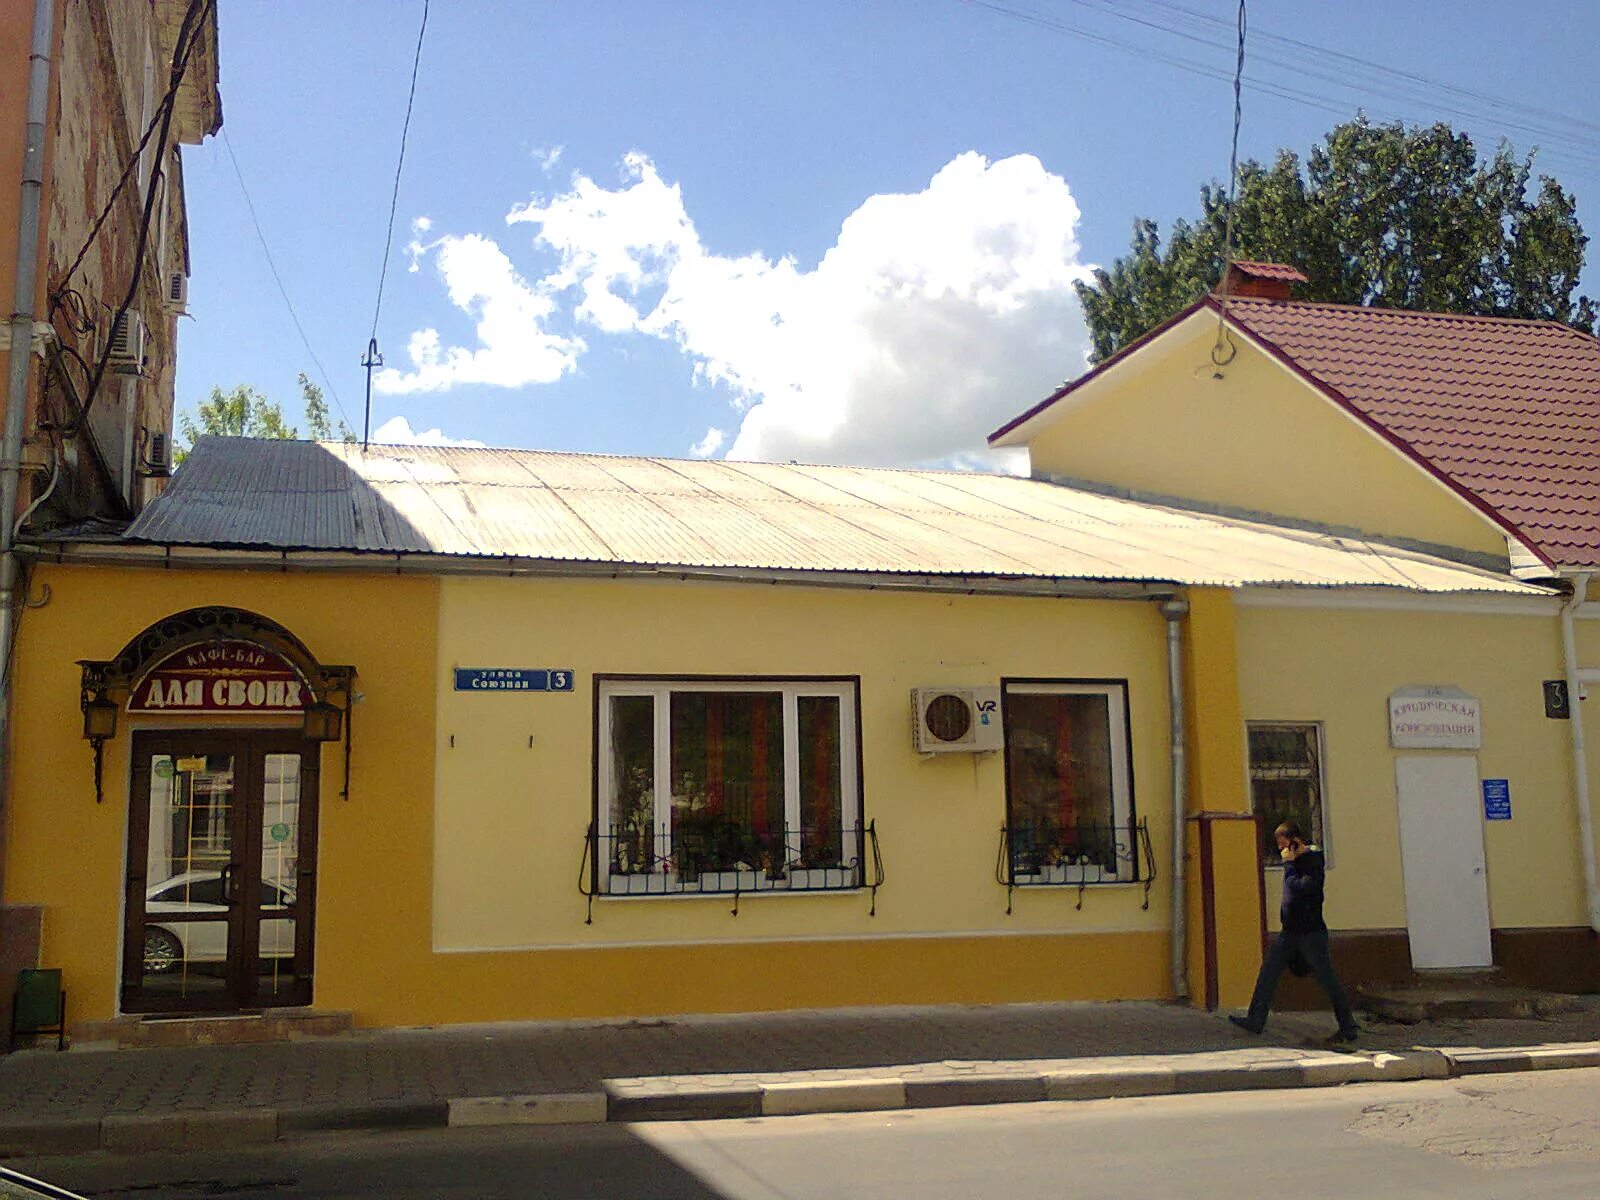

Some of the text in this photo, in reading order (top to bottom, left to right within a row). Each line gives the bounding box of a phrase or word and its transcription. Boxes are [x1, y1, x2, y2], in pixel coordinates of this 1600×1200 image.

[186, 649, 265, 666] КАФЕ-БАР
[472, 678, 529, 688] Союзная
[555, 672, 566, 688] 3
[144, 679, 302, 708] ДЛЯ СВОИХ
[1551, 683, 1563, 709] 3
